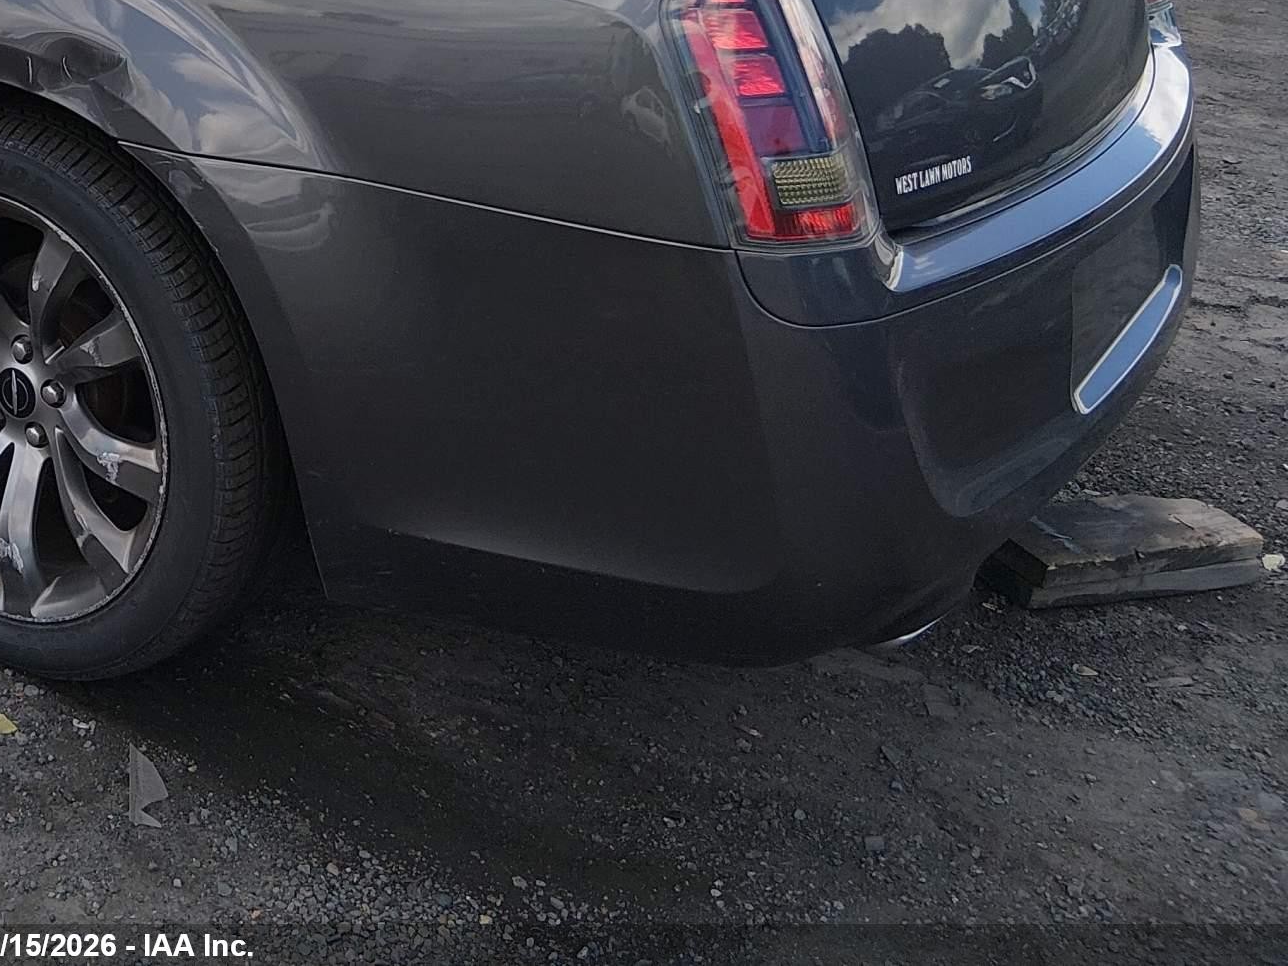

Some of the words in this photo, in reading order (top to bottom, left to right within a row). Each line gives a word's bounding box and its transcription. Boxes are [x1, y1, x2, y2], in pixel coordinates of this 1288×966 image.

[895, 172, 918, 194] WEST
[919, 166, 941, 188] LAWN
[941, 155, 972, 181] MOTORS
